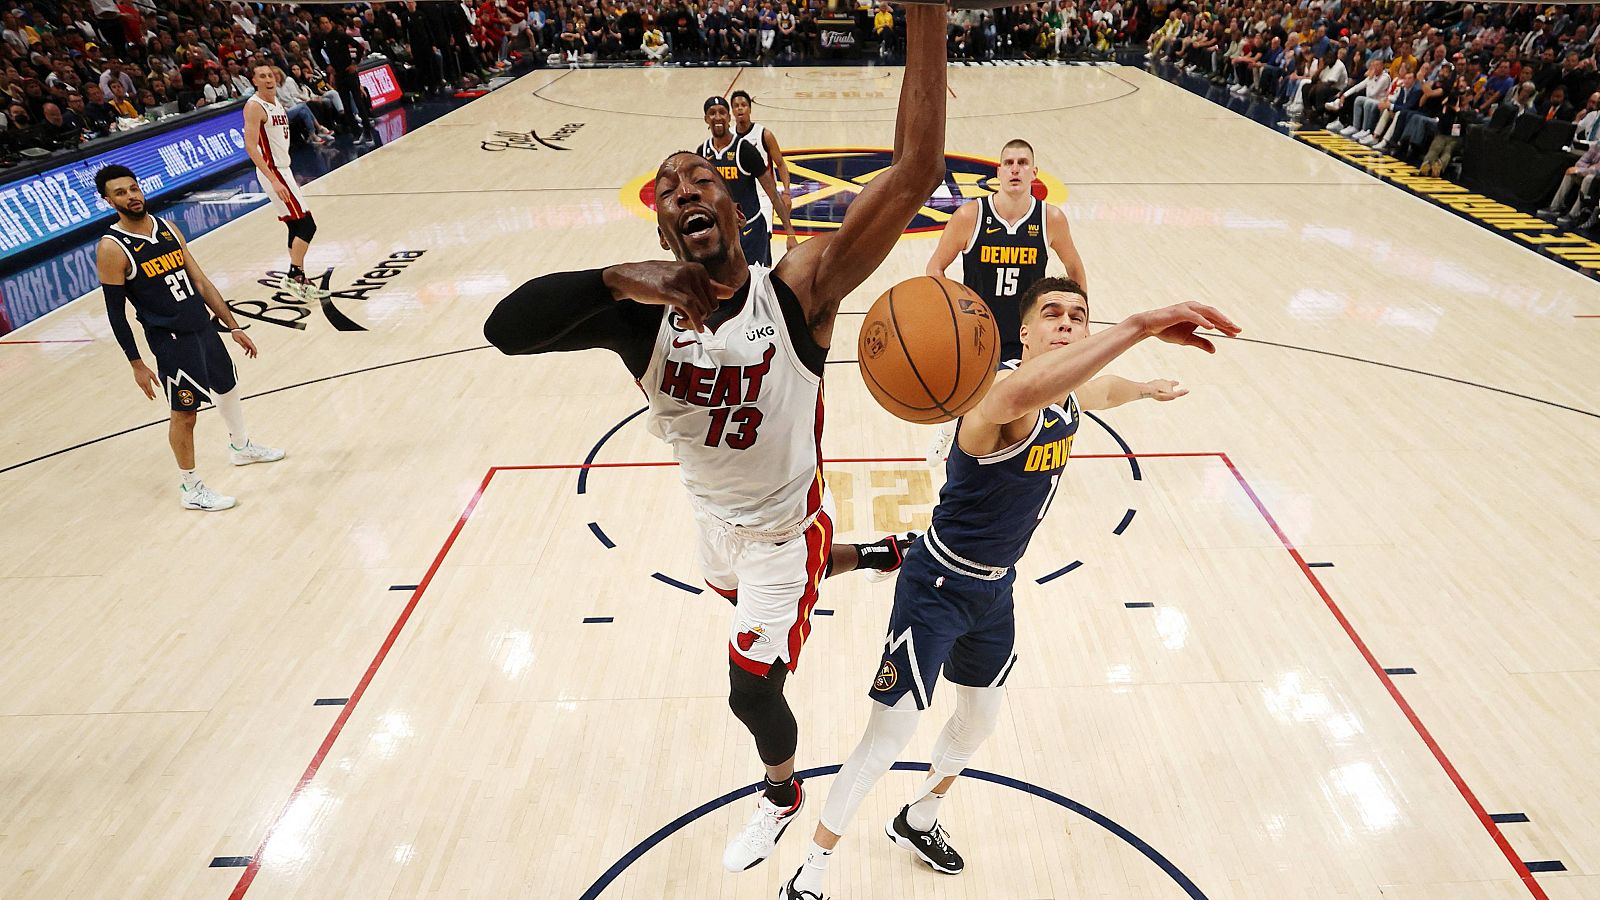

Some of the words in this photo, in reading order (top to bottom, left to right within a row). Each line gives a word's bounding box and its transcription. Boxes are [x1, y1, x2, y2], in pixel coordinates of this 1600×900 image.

[826, 31, 855, 47] Finals
[271, 114, 288, 126] HEA
[158, 143, 192, 177] JUNE
[179, 139, 204, 168] 22
[21, 172, 91, 233] 2023
[1428, 193, 1558, 230] HIGH
[140, 248, 185, 278] DENVE
[980, 246, 1038, 265] DENVER
[164, 268, 195, 302] 27
[330, 249, 427, 301] Arena
[995, 267, 1020, 297] 15
[660, 342, 776, 408] HEAT
[704, 406, 764, 451] 13
[1037, 475, 1059, 520] 1
